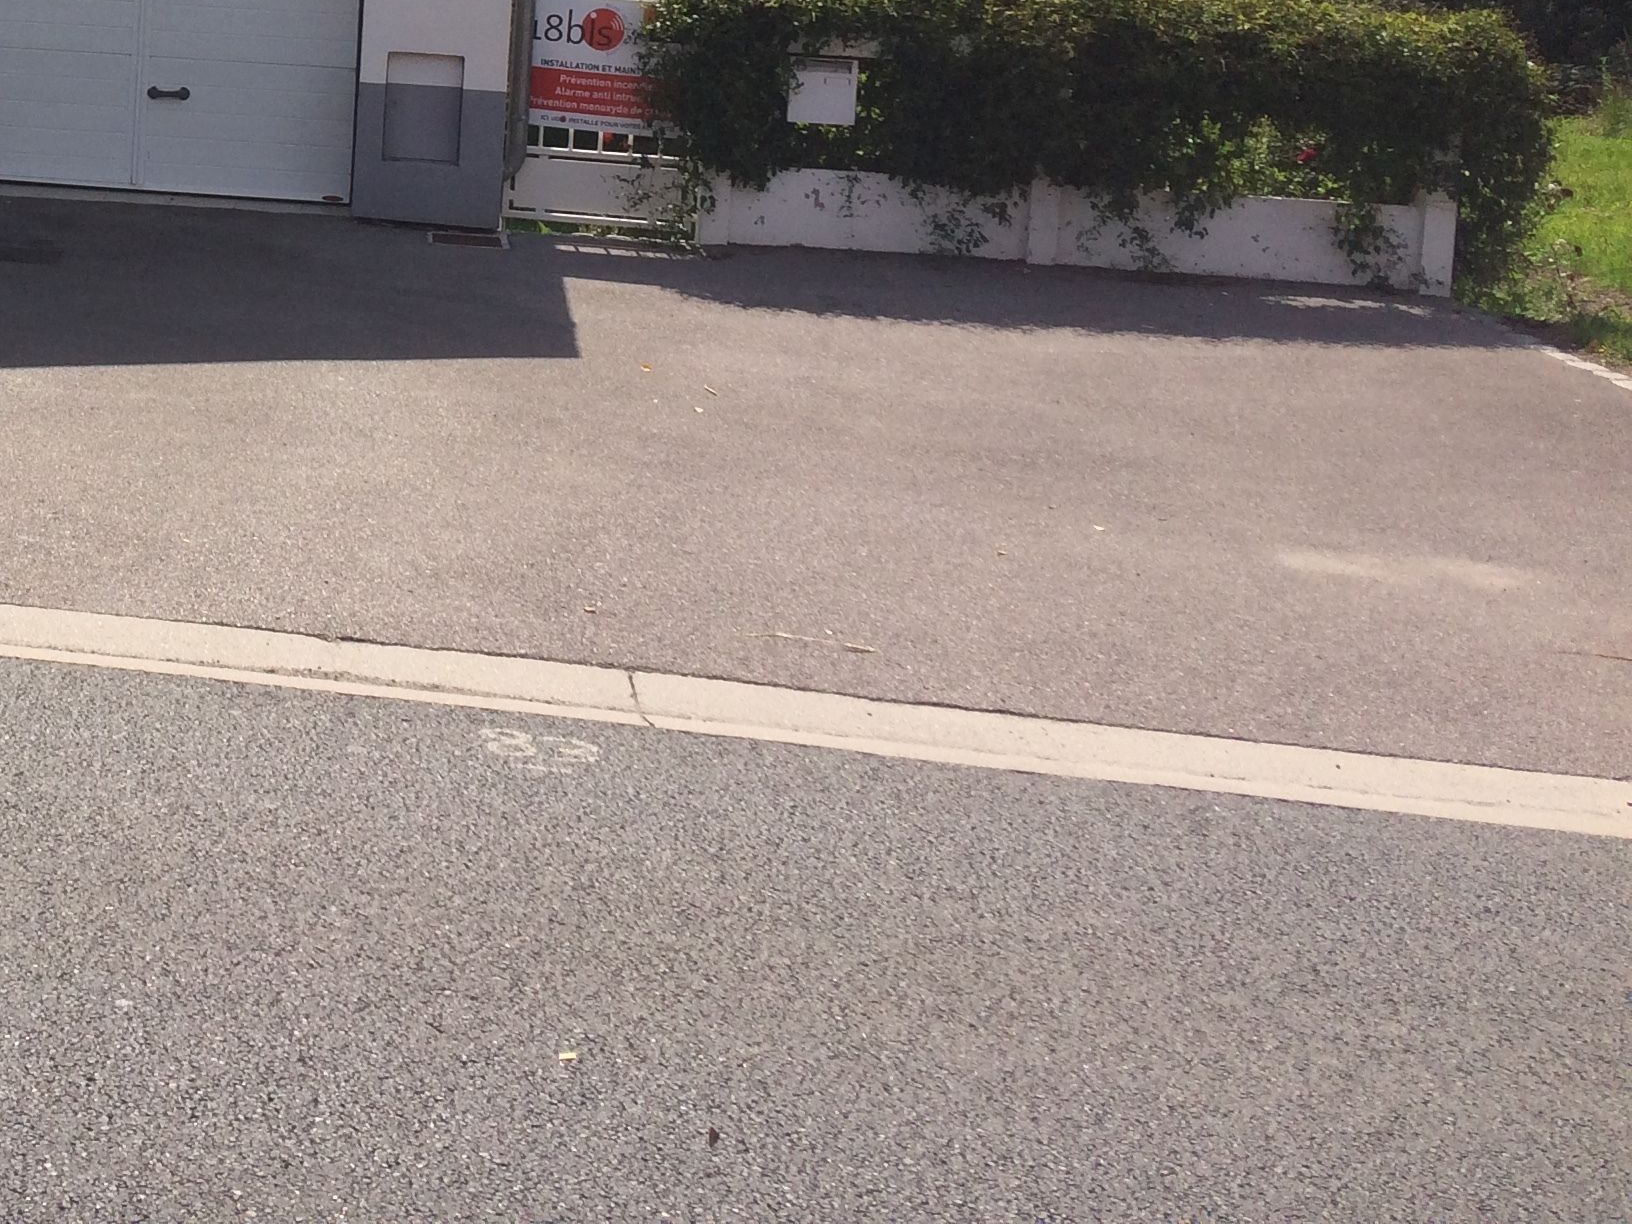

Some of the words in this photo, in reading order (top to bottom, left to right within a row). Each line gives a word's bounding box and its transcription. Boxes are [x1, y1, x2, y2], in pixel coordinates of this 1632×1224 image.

[532, 8, 613, 48] 18bis
[540, 58, 600, 72] INSTALLATION
[602, 64, 613, 73] ET
[560, 74, 611, 88] Prévention
[555, 86, 591, 97] Alarme
[592, 90, 611, 100] anti
[579, 102, 628, 115] monoxyde
[630, 104, 642, 115] de
